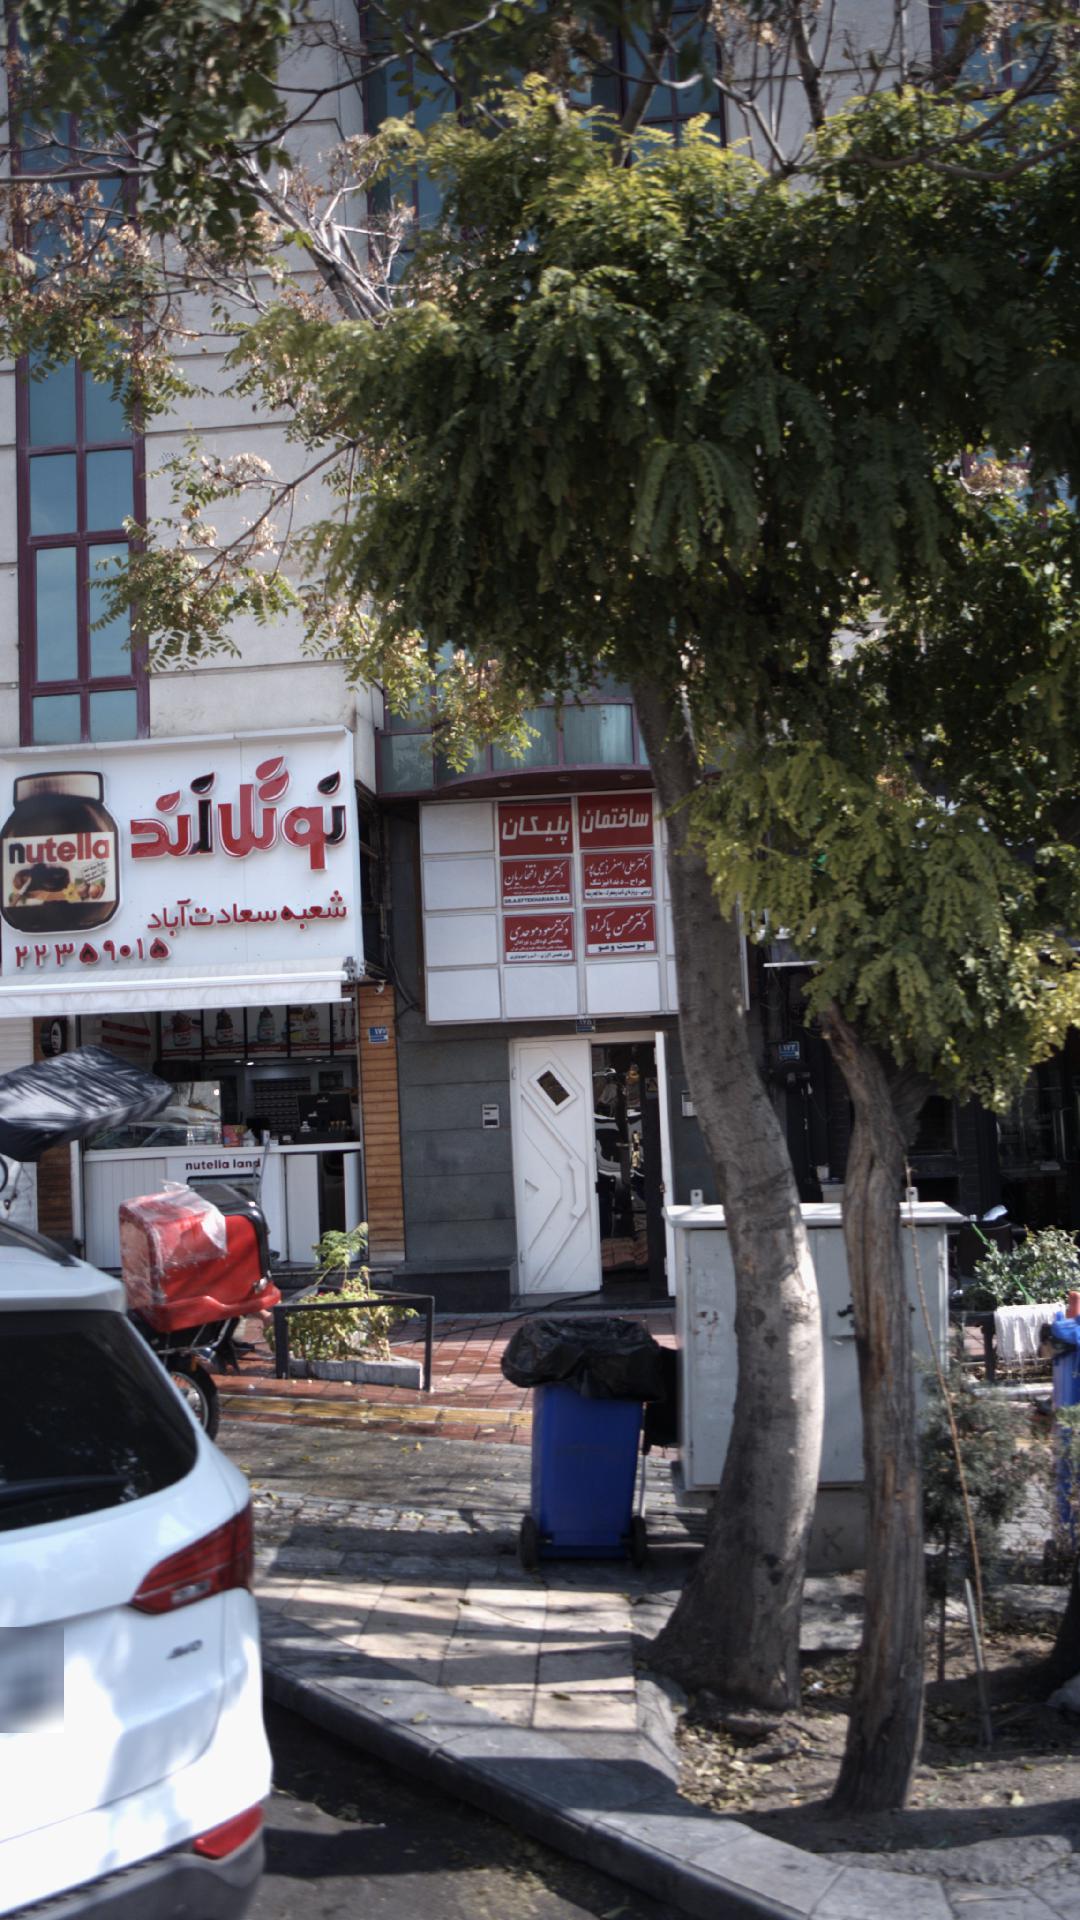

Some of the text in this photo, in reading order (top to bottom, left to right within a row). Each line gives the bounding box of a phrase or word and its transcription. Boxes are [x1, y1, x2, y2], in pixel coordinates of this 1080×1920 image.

[502, 807, 650, 846] ساختمان پلیکان
[8, 832, 110, 864] nutella
[504, 860, 568, 886] دکتر علی افتخاریان
[624, 861, 636, 876] علی
[634, 853, 651, 873] دکتر
[281, 889, 347, 930] شعبه
[509, 926, 540, 941] موحدی
[550, 915, 570, 939] دکتر
[590, 910, 652, 940] دکتر محسن پاکزاد
[185, 1157, 261, 1171] nutella land
